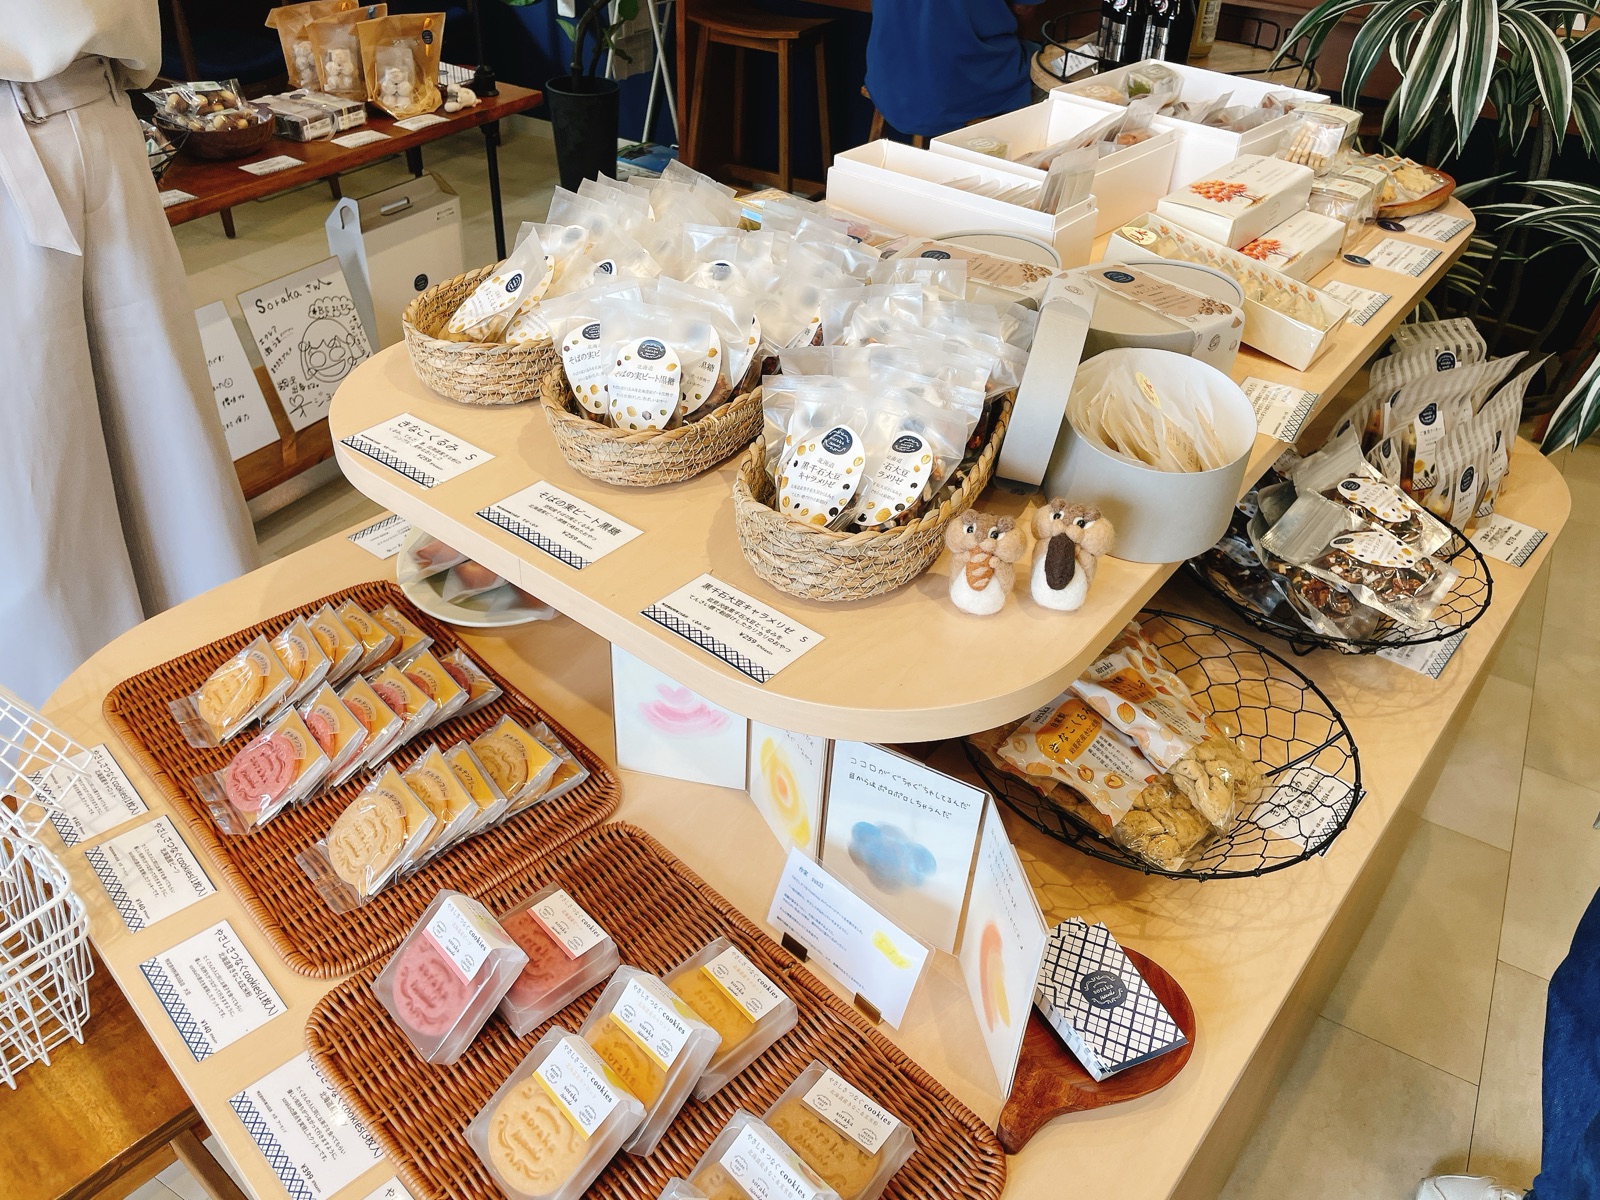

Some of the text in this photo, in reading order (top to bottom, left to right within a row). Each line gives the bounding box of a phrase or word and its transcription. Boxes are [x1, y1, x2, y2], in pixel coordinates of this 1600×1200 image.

[395, 419, 462, 453] きなこくるみ
[463, 453, 478, 461] S
[798, 471, 836, 488] キャラメリゼ
[801, 461, 842, 480] 黒千石大豆
[535, 490, 624, 536] そばの実ビート黒糖
[559, 530, 579, 541] ¥259
[699, 581, 809, 643] 黒千石大豆キャラメリゼ S
[736, 631, 758, 644] ¥259
[151, 821, 208, 898] やさしさつなぐcookies(1枚入)
[134, 897, 146, 910] ¥140
[553, 920, 568, 934] soraka
[580, 917, 602, 937] cookies
[447, 937, 460, 953] soraka
[467, 927, 488, 952] cookies
[211, 927, 279, 1017] やさしさつなぐcookies(1枚入)
[729, 980, 745, 995] soraka
[755, 976, 781, 999] cookies
[199, 1019, 212, 1034] ¥140
[638, 1021, 655, 1038] soraka
[661, 1010, 687, 1035] cookies
[562, 1084, 579, 1103] soraka
[589, 1074, 614, 1103] cookies
[295, 1084, 346, 1156] たくさんの人に同じお菓子を食べてもらい
[835, 1110, 854, 1127] soraka
[862, 1102, 893, 1126] cookies
[299, 1162, 314, 1181] ¥399
[750, 1177, 770, 1198] soraka
[778, 1167, 808, 1199] cookies
